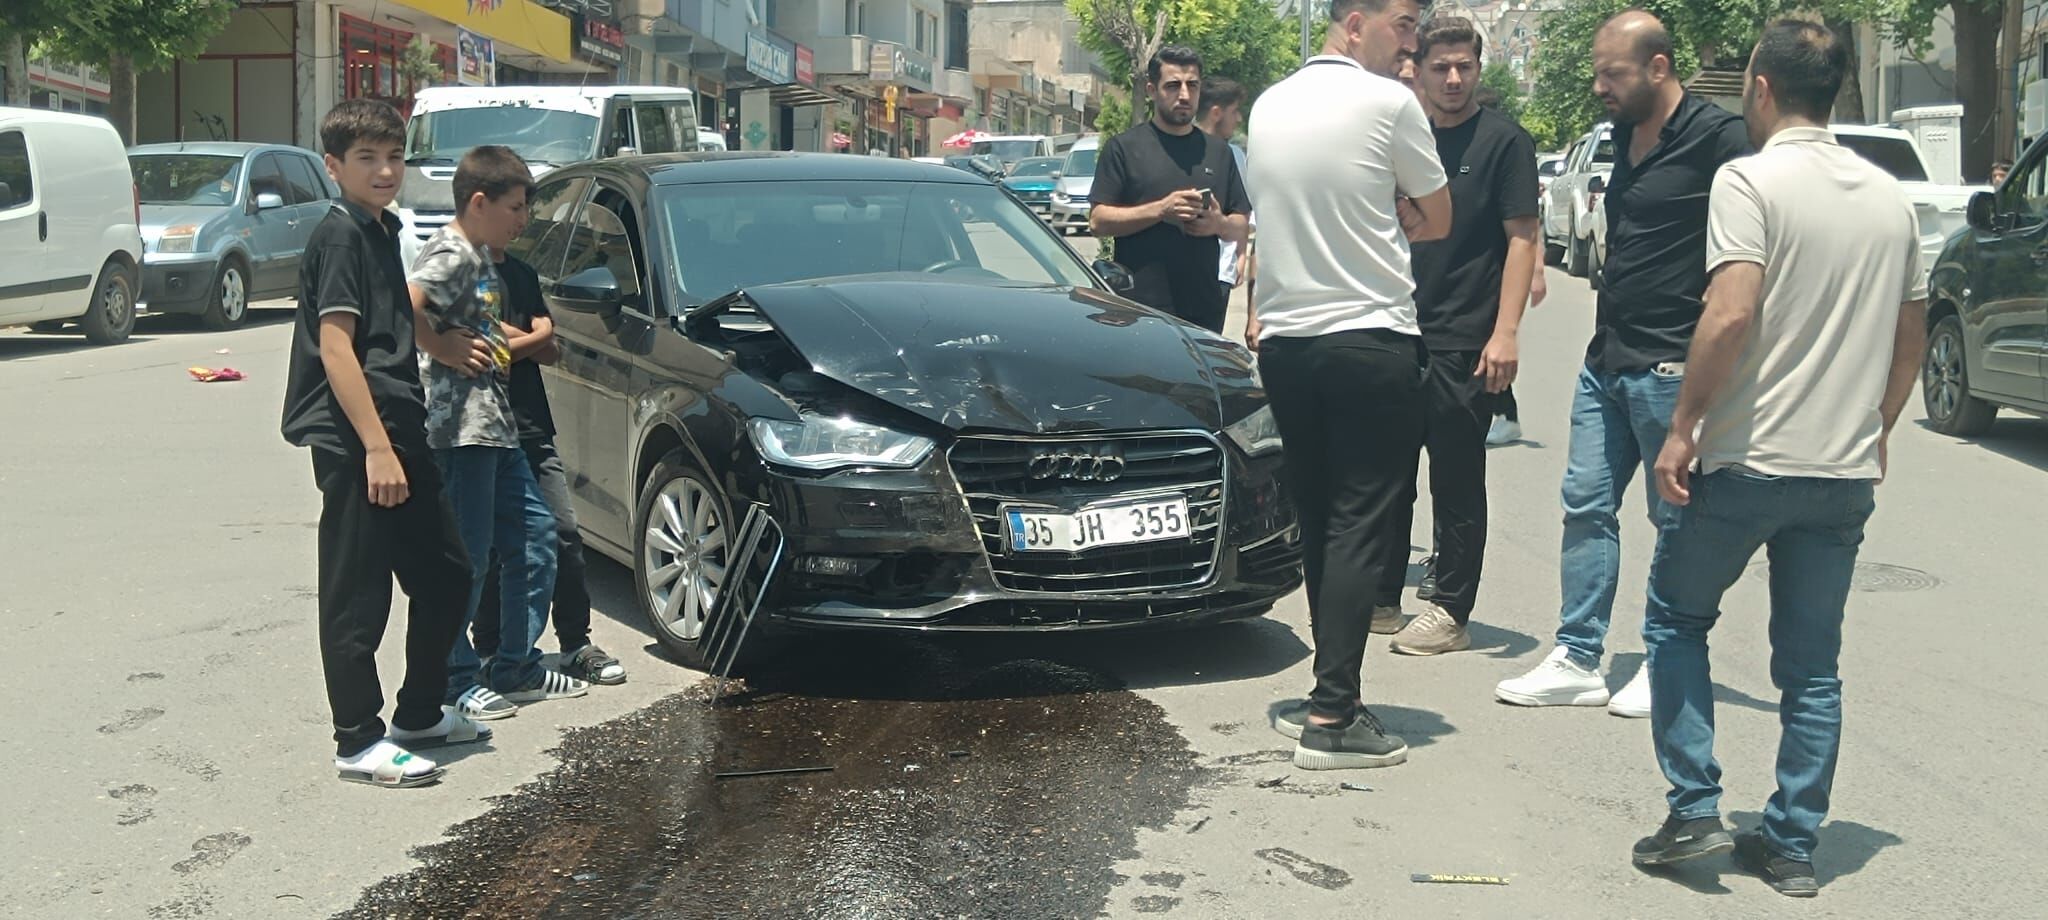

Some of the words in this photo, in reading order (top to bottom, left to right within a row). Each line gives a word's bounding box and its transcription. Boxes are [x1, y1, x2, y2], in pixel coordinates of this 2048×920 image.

[1014, 533, 1025, 542] TR
[1025, 517, 1053, 546] 35
[1073, 513, 1105, 546] JH
[1129, 504, 1181, 537] 355
